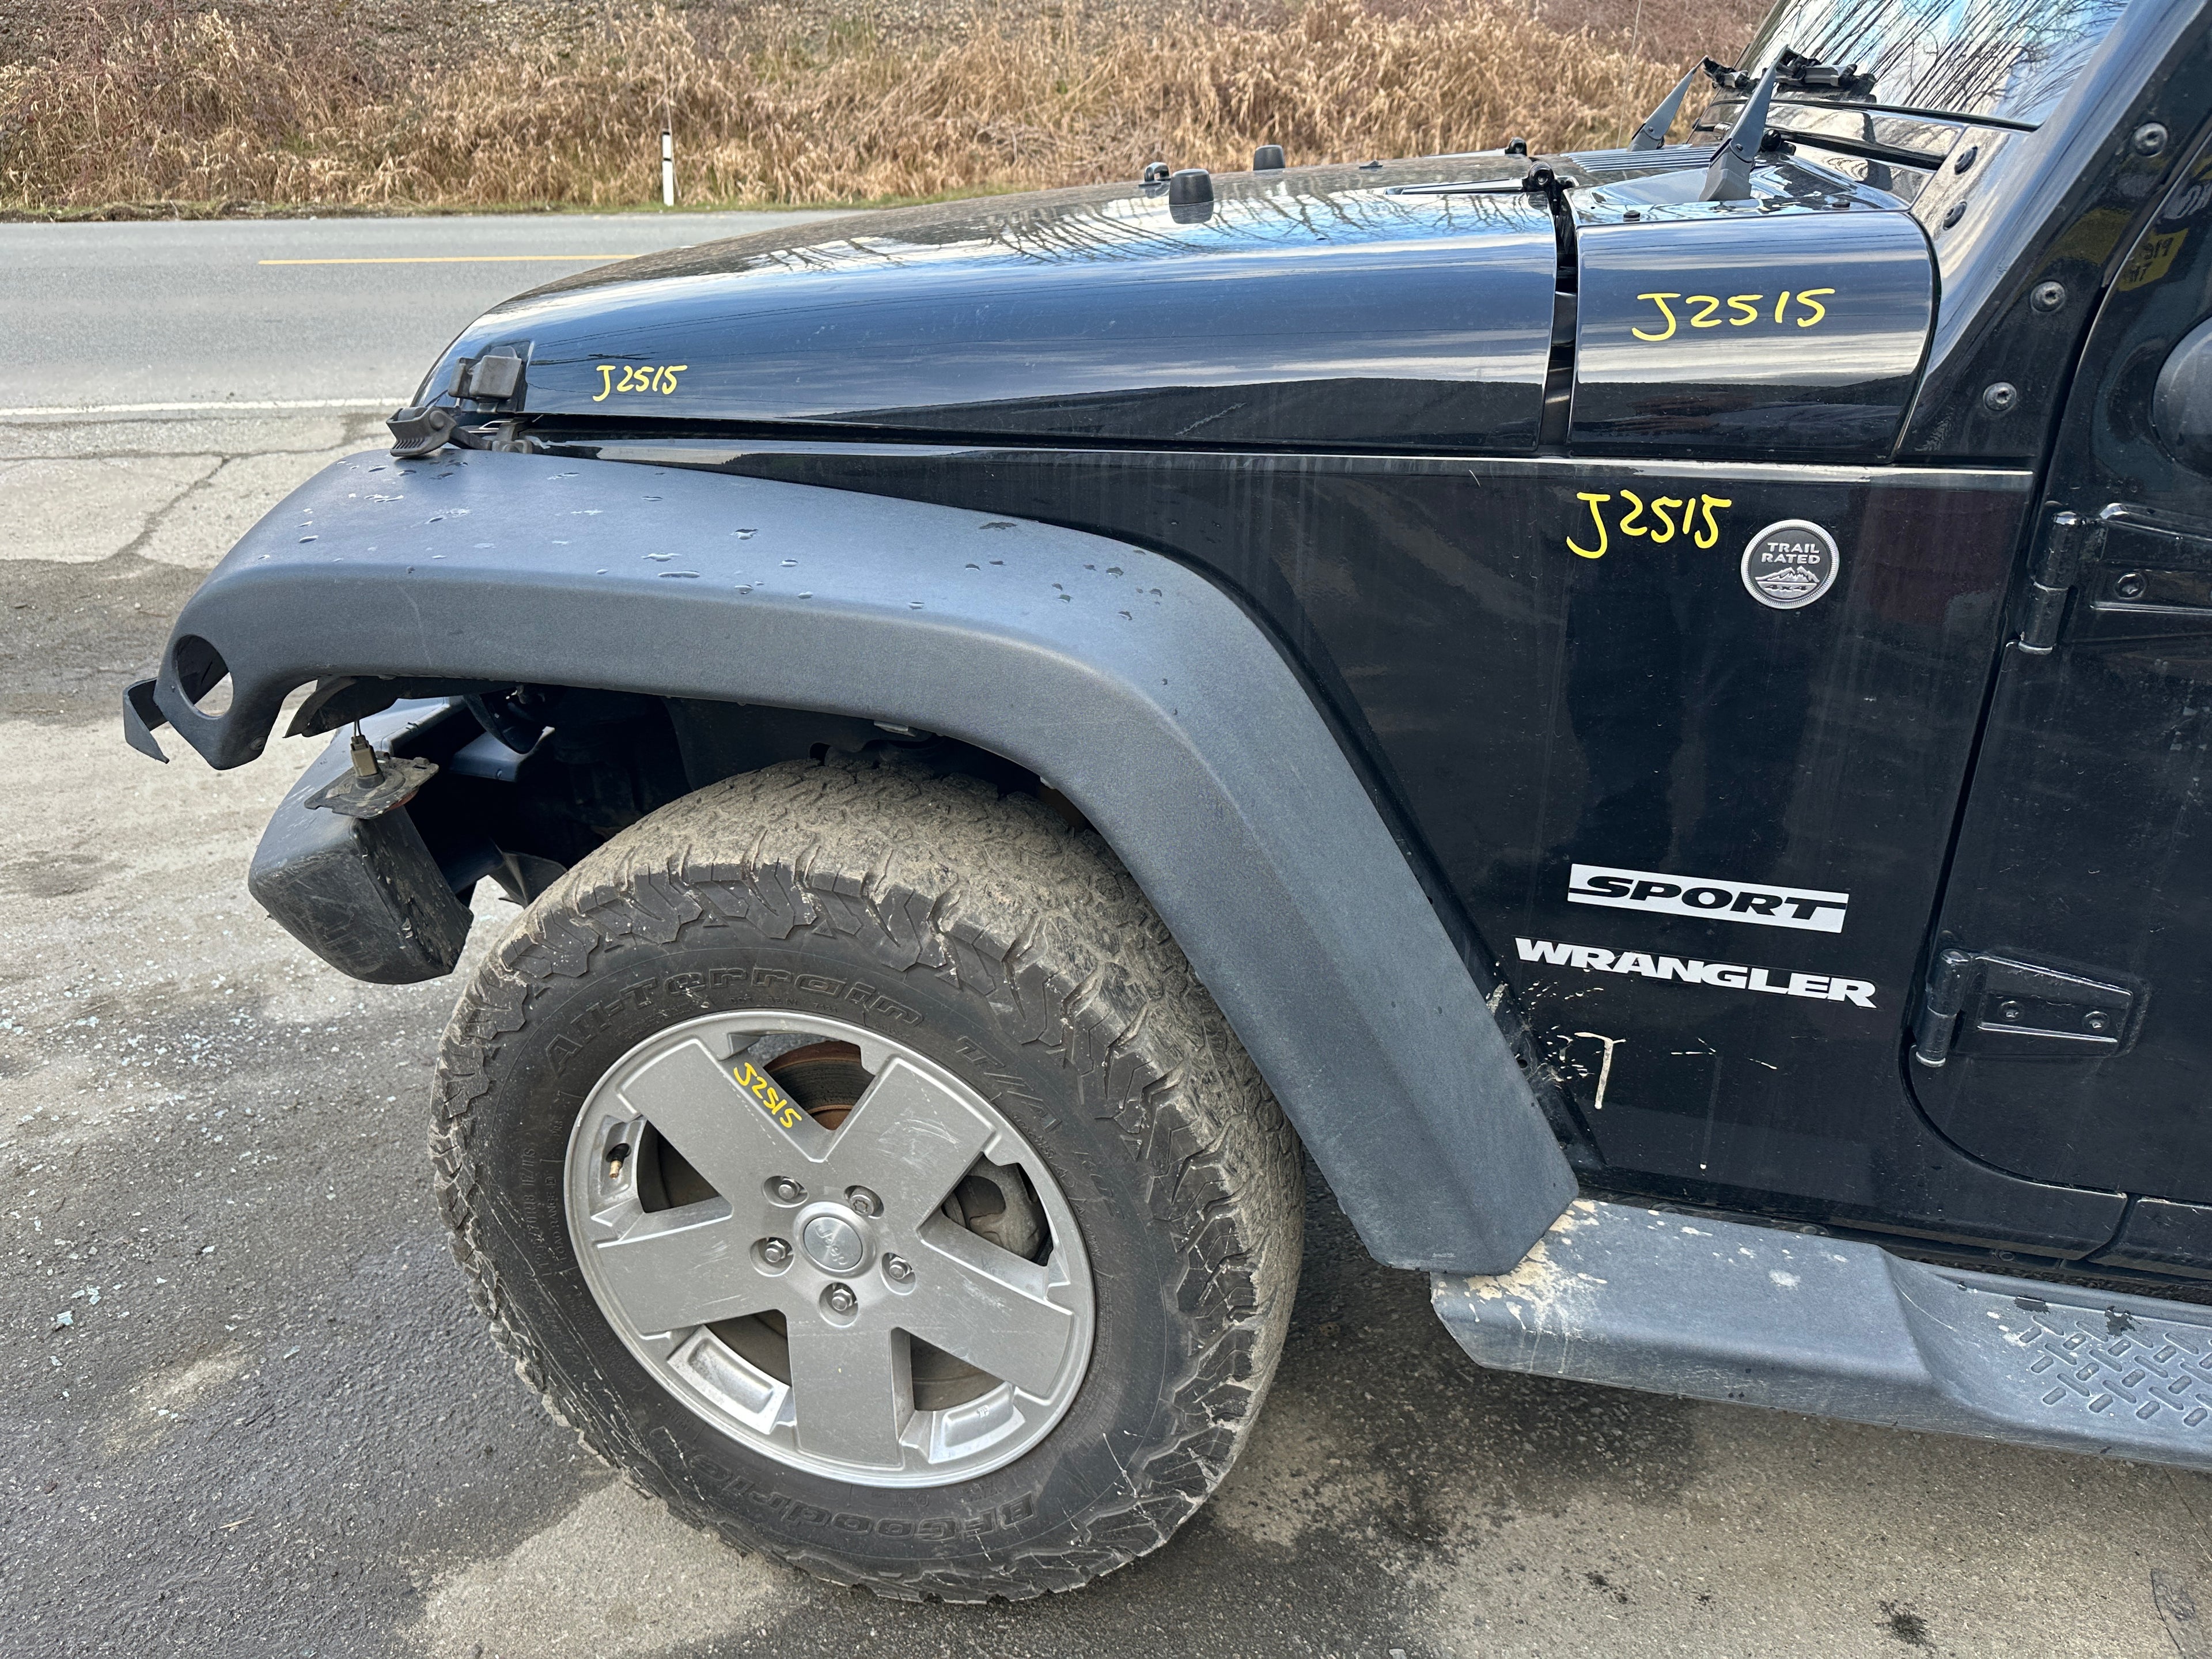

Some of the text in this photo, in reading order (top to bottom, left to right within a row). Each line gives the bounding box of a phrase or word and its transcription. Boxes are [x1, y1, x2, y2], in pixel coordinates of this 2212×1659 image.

[1631, 288, 1835, 342] J2515
[592, 365, 688, 402] J2515
[1566, 490, 1732, 559] J2515
[1761, 552, 1820, 565] RATED
[1768, 542, 1819, 554] TRAIL
[1586, 875, 1827, 921] SPORT
[1514, 937, 1877, 1009] WRANGLER
[733, 1062, 802, 1128] J2515
[815, 1225, 848, 1265] Jeep
